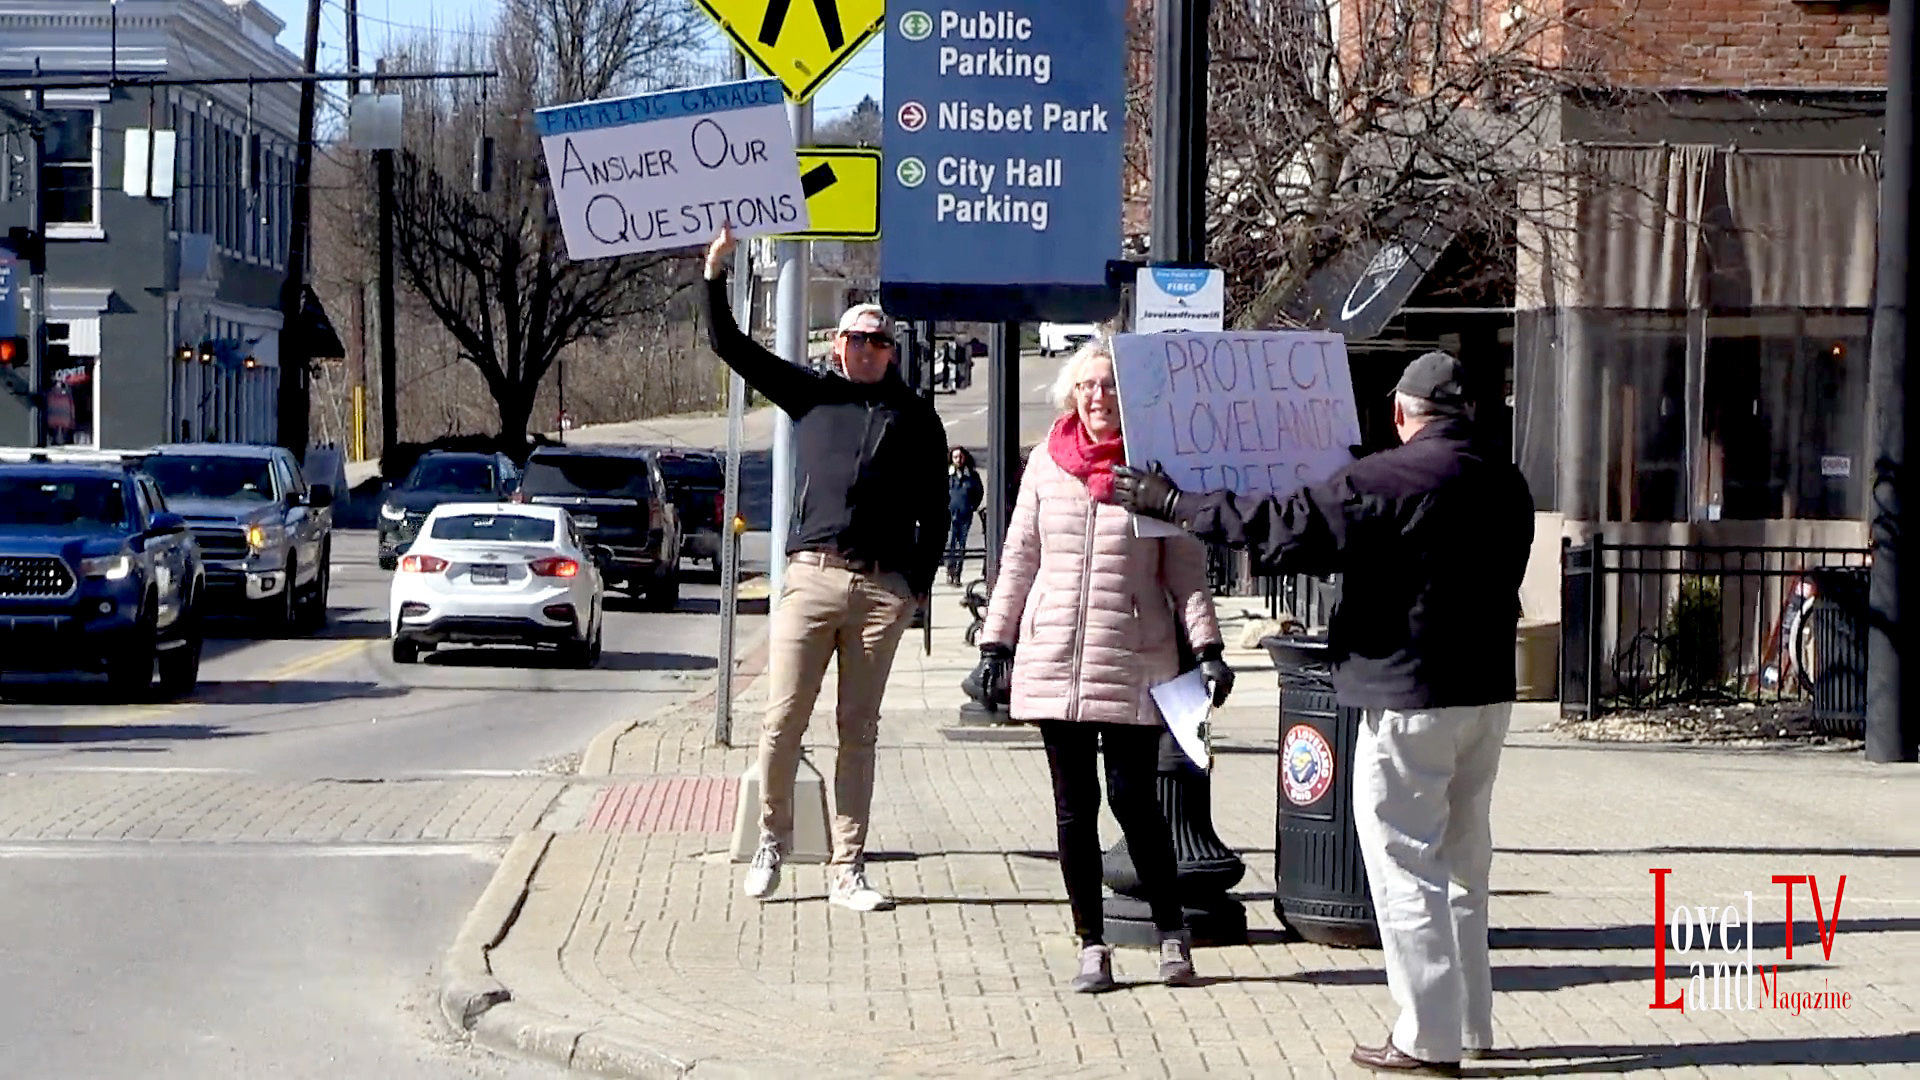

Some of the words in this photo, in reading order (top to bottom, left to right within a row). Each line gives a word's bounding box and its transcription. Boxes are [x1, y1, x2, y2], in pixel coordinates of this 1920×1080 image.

[940, 10, 1032, 40] Public
[939, 47, 1051, 84] Parking
[938, 102, 1033, 131] Nisbet
[1043, 103, 1109, 132] Park
[937, 156, 996, 193] City
[1006, 158, 1062, 187] Hall
[936, 194, 1049, 231] Parking
[1165, 338, 1333, 393] PROTECT
